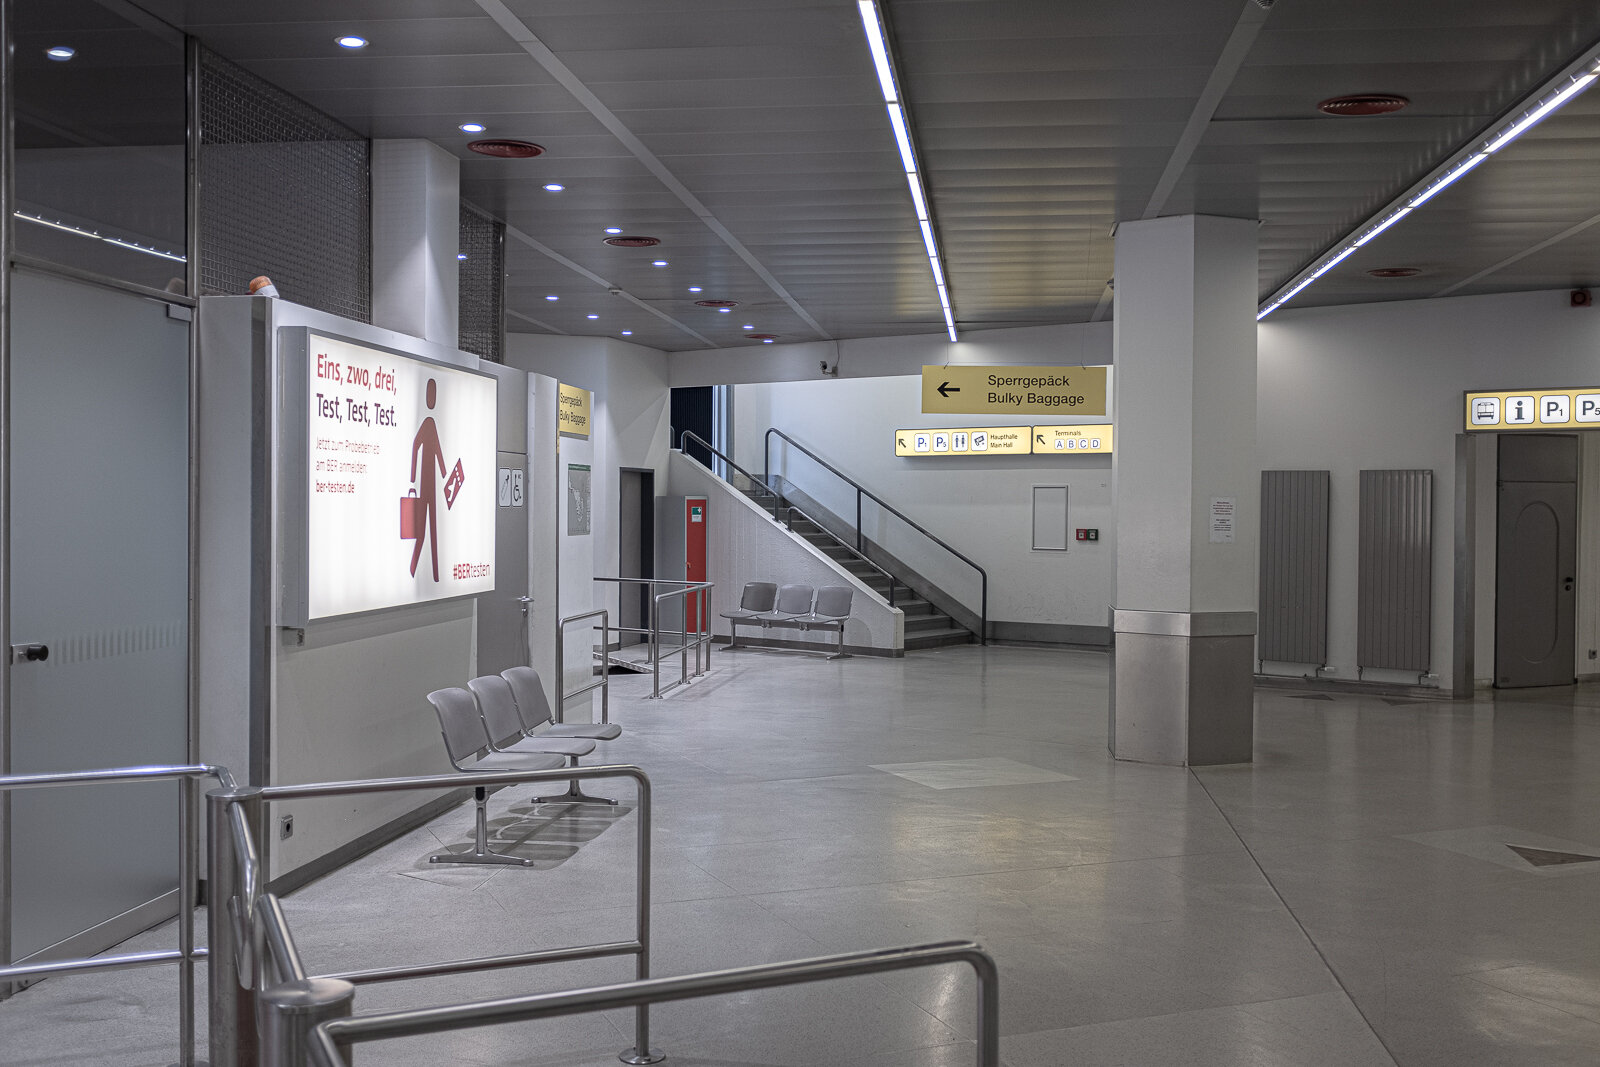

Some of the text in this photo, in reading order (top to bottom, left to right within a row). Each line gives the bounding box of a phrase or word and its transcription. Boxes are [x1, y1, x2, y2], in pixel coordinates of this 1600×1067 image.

[317, 353, 397, 396] Eins, zwo, drei,
[987, 374, 1070, 388] Sperrgepäck
[987, 392, 1085, 406] Bulky Baggage
[316, 393, 397, 427] Test, Test, Test.
[1546, 401, 1563, 416] P1
[570, 411, 586, 427] Baggage
[1056, 439, 1099, 448] A B C D
[316, 460, 325, 472] am
[326, 459, 338, 472] BER
[315, 479, 355, 494] ber-testen.de
[453, 563, 491, 580] #BERtesten
